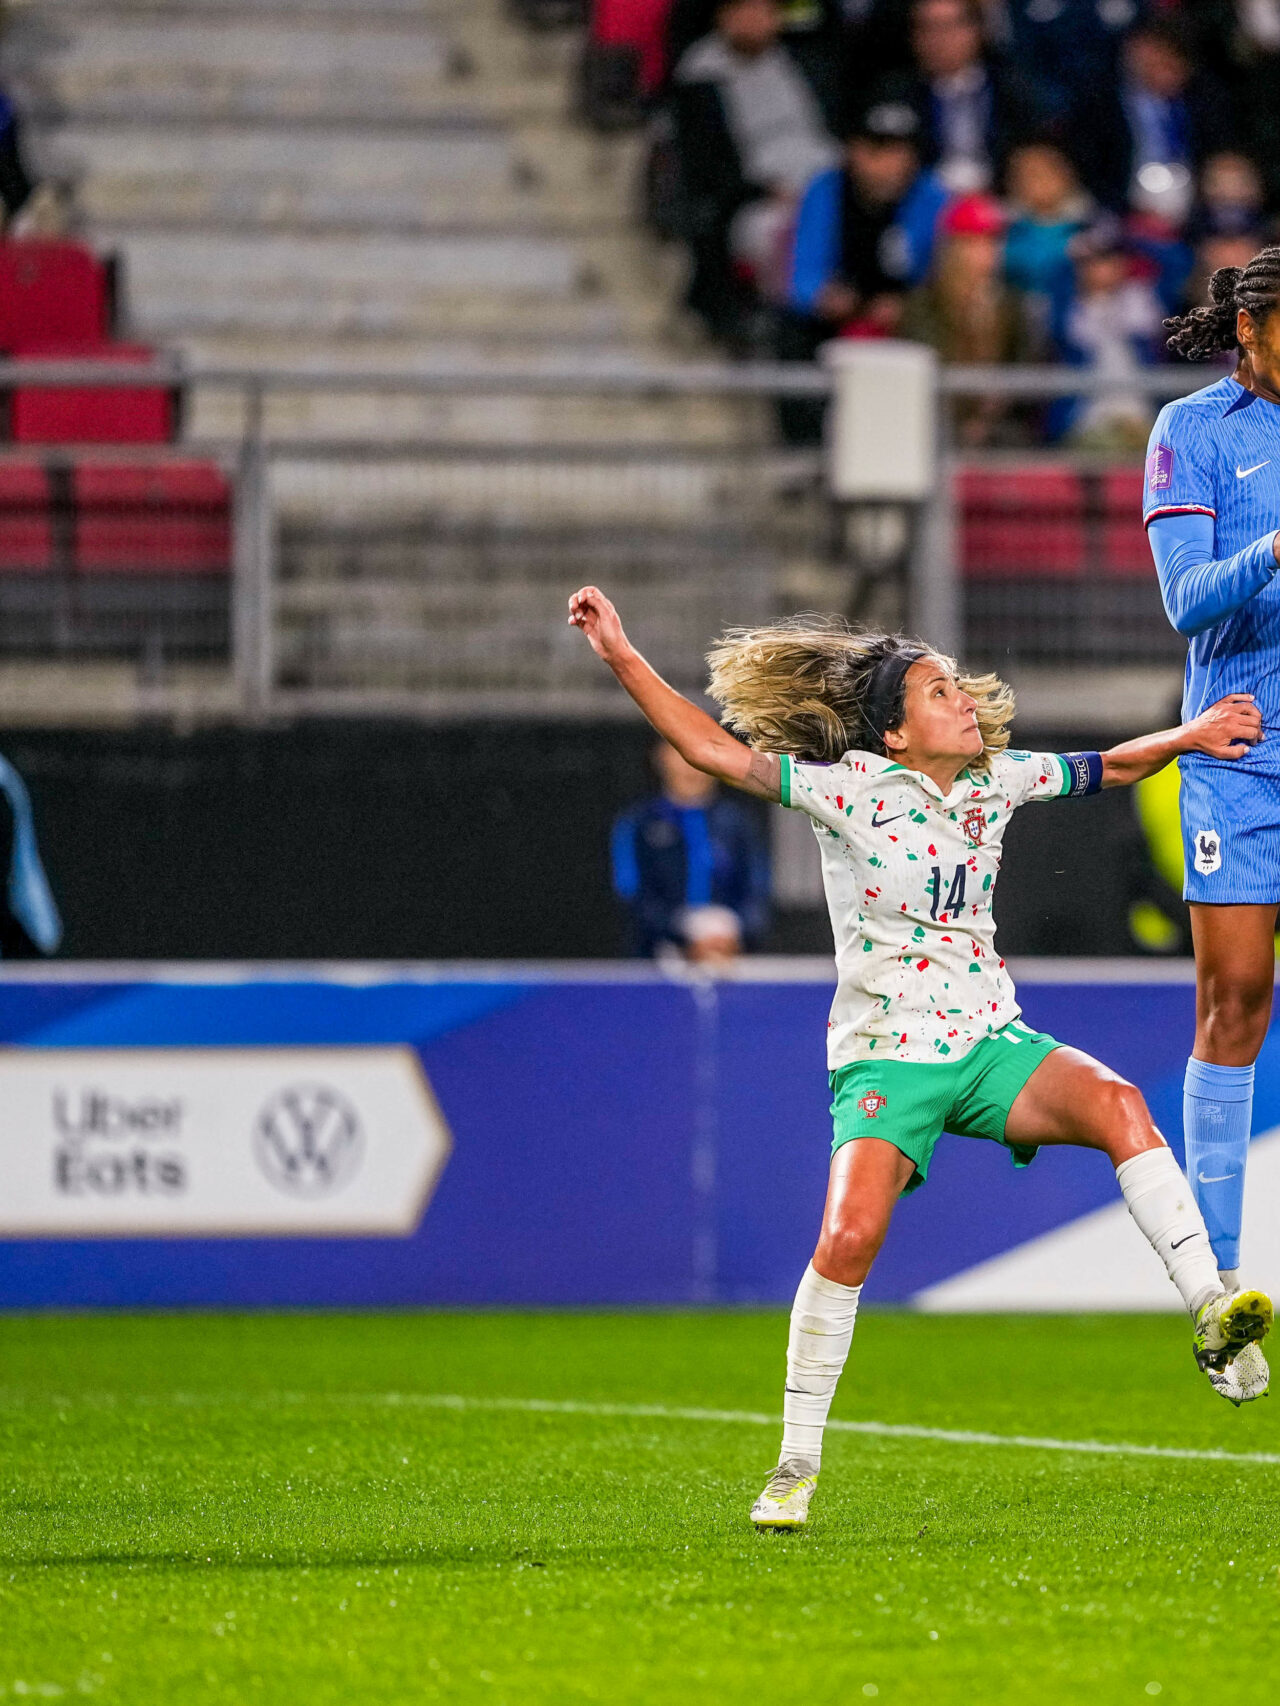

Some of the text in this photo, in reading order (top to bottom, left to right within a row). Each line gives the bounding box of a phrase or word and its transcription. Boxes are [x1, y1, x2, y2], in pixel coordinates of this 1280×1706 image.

[1075, 758, 1089, 792] RESPECT
[930, 864, 966, 921] 14
[53, 1086, 182, 1136] Uber
[54, 1143, 186, 1197] Eats
